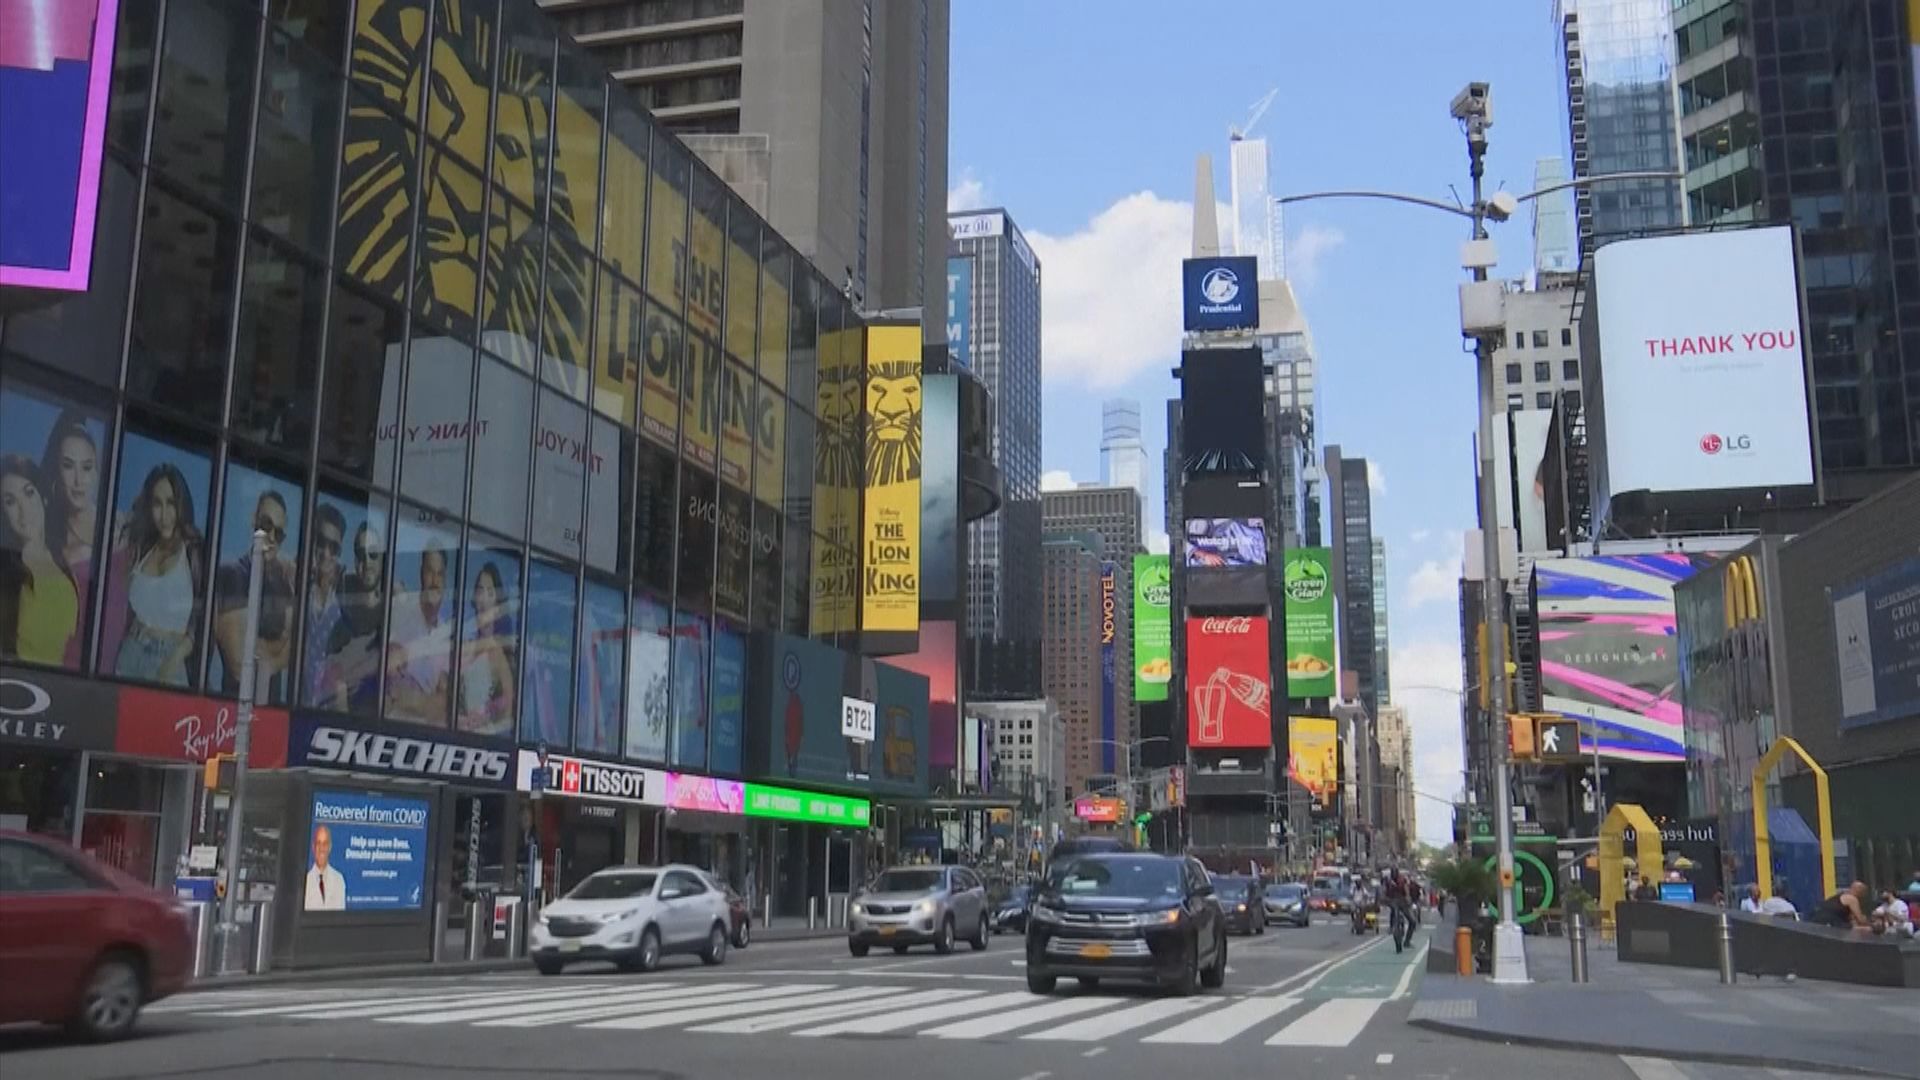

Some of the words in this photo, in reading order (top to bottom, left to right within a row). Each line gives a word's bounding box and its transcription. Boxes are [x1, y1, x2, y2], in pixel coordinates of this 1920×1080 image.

[1200, 303, 1242, 313] Prudential
[1645, 334, 1733, 357] THANK
[1742, 331, 1795, 351] YOU
[1727, 435, 1751, 449] LG
[875, 524, 904, 537] THE
[869, 540, 910, 565] LION
[866, 566, 916, 596] KING
[1288, 578, 1324, 589] Green
[1292, 588, 1324, 598] Giant
[1102, 571, 1115, 643] NOVOTEL
[1564, 651, 1641, 664] DESIGNED
[846, 706, 872, 732] BT21
[175, 707, 240, 757] Ray-Ba
[307, 727, 510, 781] SKECHERS
[583, 766, 644, 797] TISSOT
[315, 802, 368, 820] Recovered
[368, 804, 393, 822] from
[393, 807, 427, 825] COVID?
[1688, 825, 1714, 841] hut
